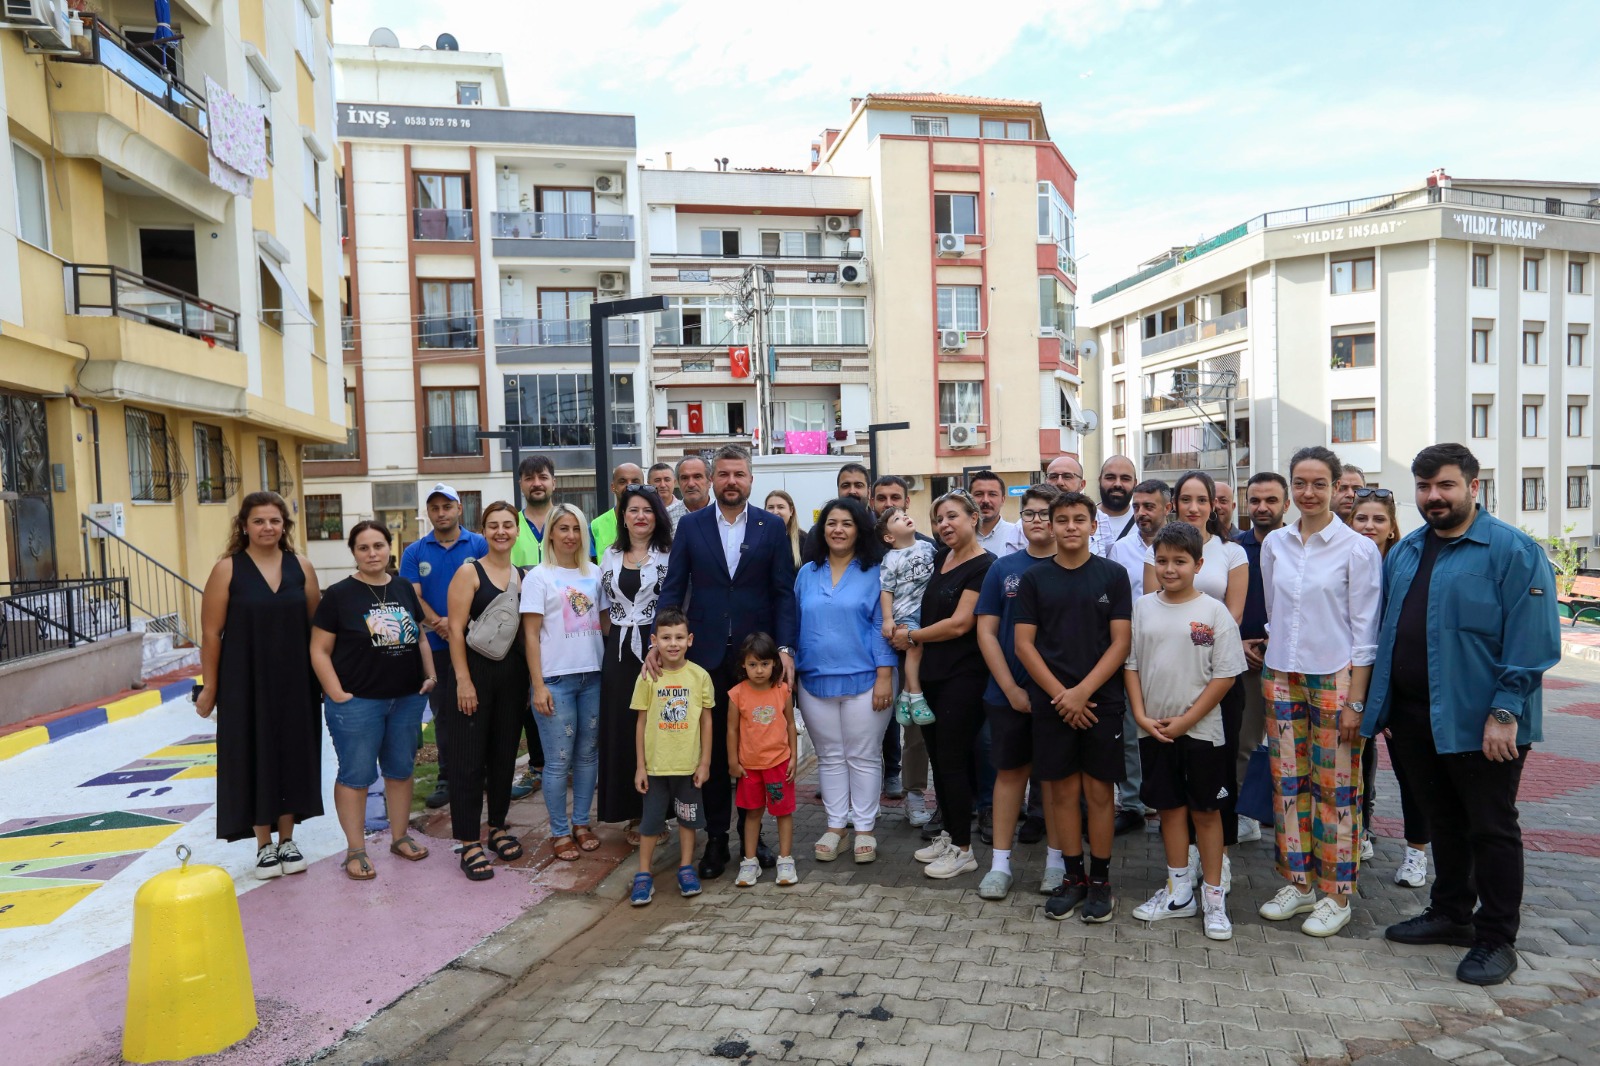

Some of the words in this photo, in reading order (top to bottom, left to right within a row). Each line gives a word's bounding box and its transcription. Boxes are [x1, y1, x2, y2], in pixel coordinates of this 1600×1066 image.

[347, 105, 397, 129] İNŞ.
[404, 116, 426, 126] 0533
[429, 117, 445, 127] 572
[1461, 214, 1497, 236] YILDIZ
[1302, 228, 1344, 244] YILDIZ
[369, 605, 407, 617] positive
[657, 689, 671, 697] MAX
[668, 722, 689, 730] RULES
